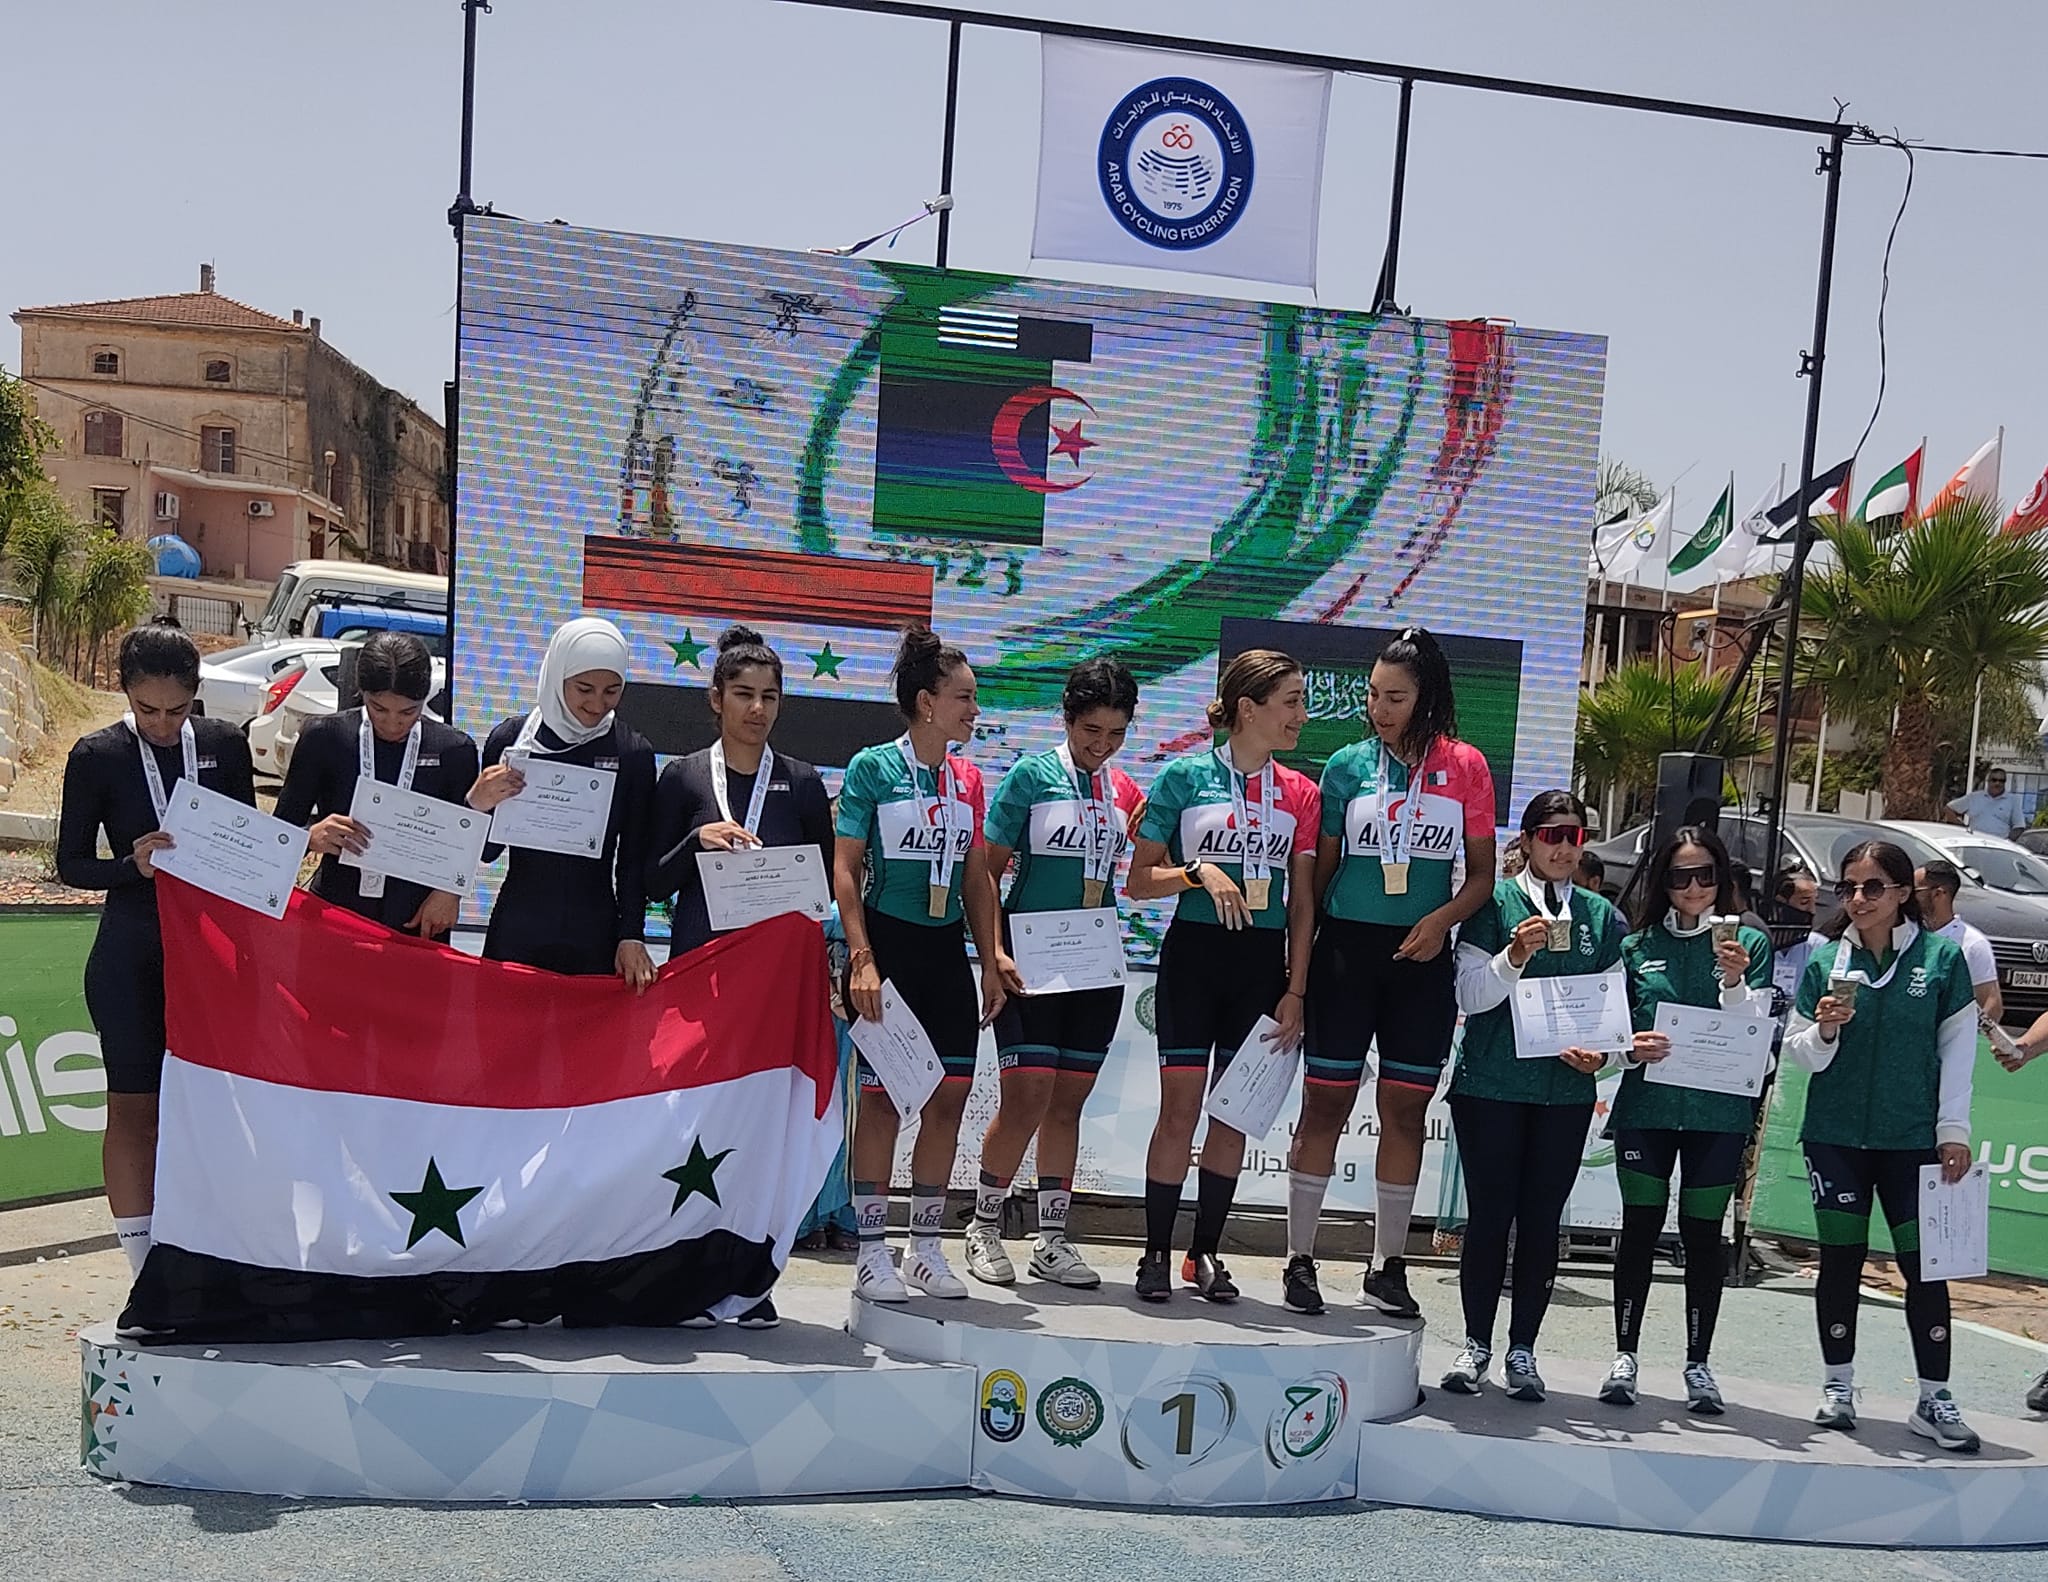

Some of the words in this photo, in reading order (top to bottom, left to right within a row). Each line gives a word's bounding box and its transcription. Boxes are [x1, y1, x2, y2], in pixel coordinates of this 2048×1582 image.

[1112, 92, 1160, 139] للدراجات
[1161, 91, 1215, 112] العربي
[1107, 161, 1127, 203] ARAB
[1122, 203, 1179, 240] CYCLING
[1180, 176, 1243, 240] FEDERATION
[1163, 200, 1183, 211] 1975
[1161, 1393, 1197, 1455] 1
